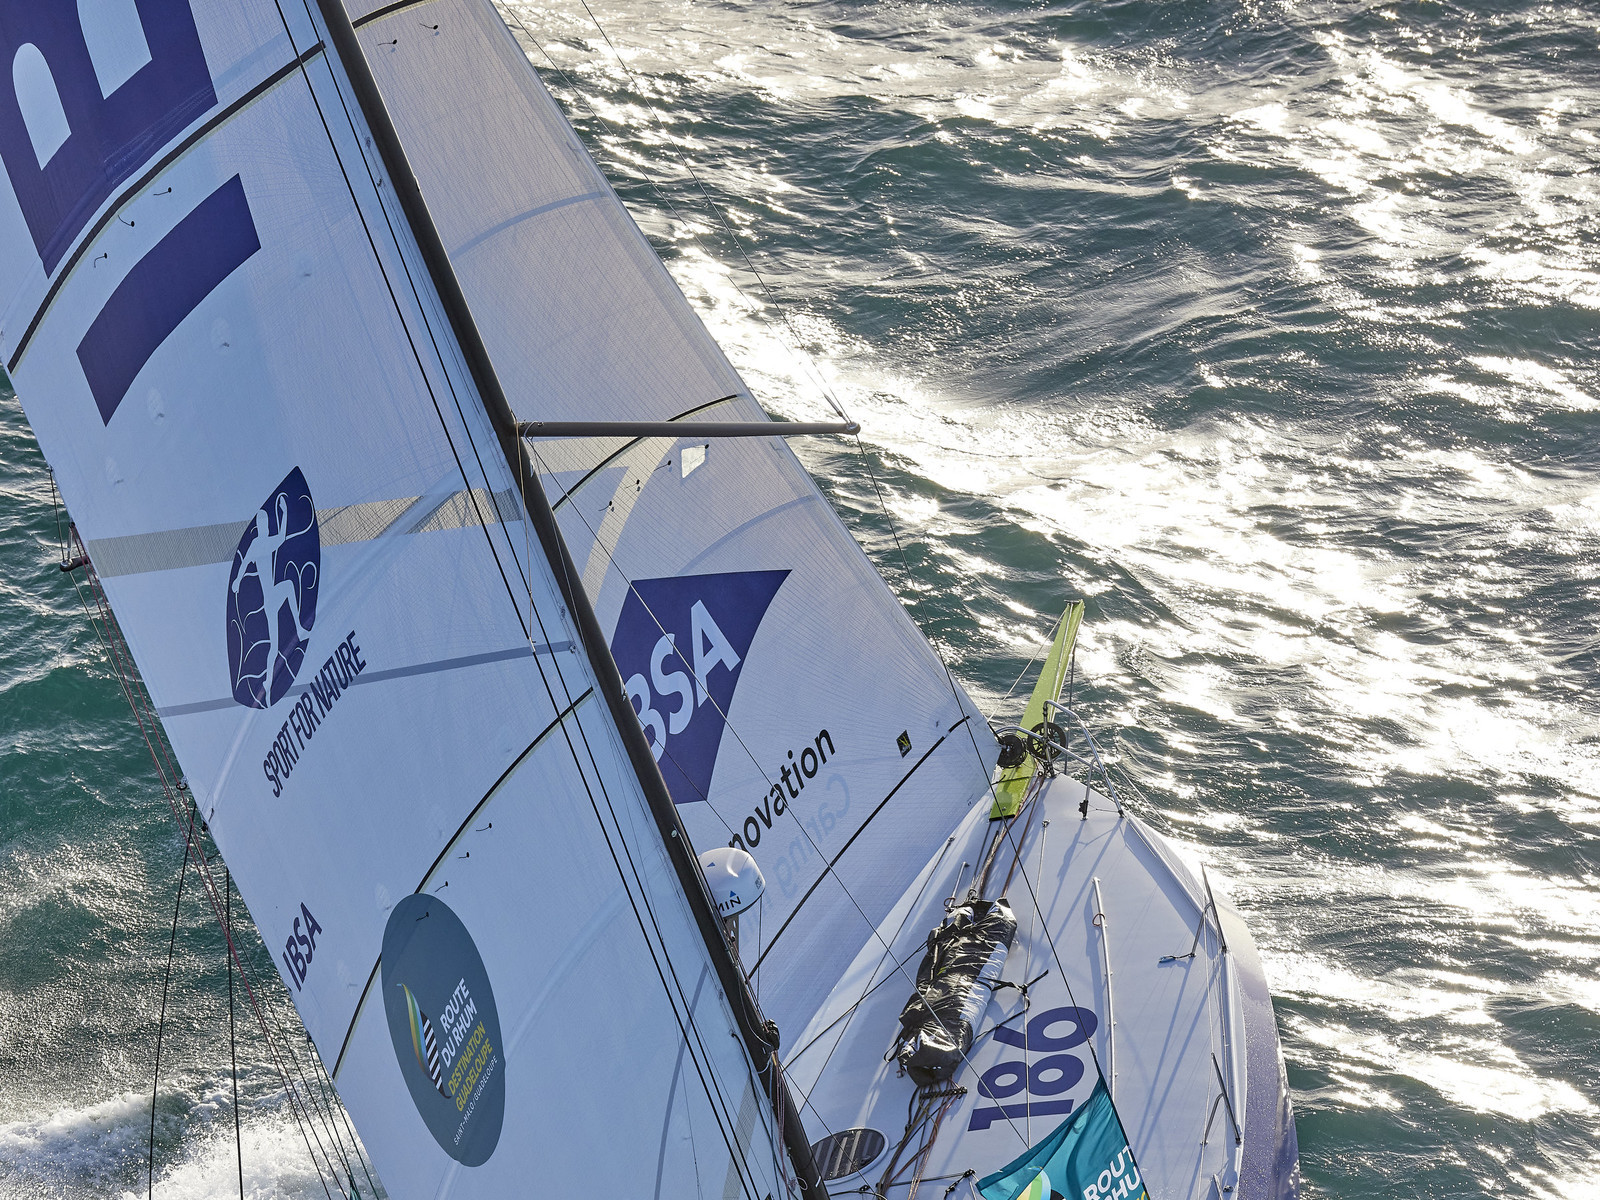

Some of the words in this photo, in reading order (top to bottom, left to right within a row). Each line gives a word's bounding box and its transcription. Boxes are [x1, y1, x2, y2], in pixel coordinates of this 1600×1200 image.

[263, 720, 300, 798] SPORT
[288, 691, 321, 751] FOR
[309, 629, 367, 719] NATURE
[624, 599, 741, 763] BSA
[282, 902, 322, 992] IBSA
[440, 978, 470, 1034] ROUTE
[441, 1037, 456, 1069] DU
[452, 997, 478, 1048] RHUM
[447, 1020, 486, 1096] DESTINATION
[455, 1038, 493, 1112] GUADELOUPE
[968, 1006, 1098, 1131] 186
